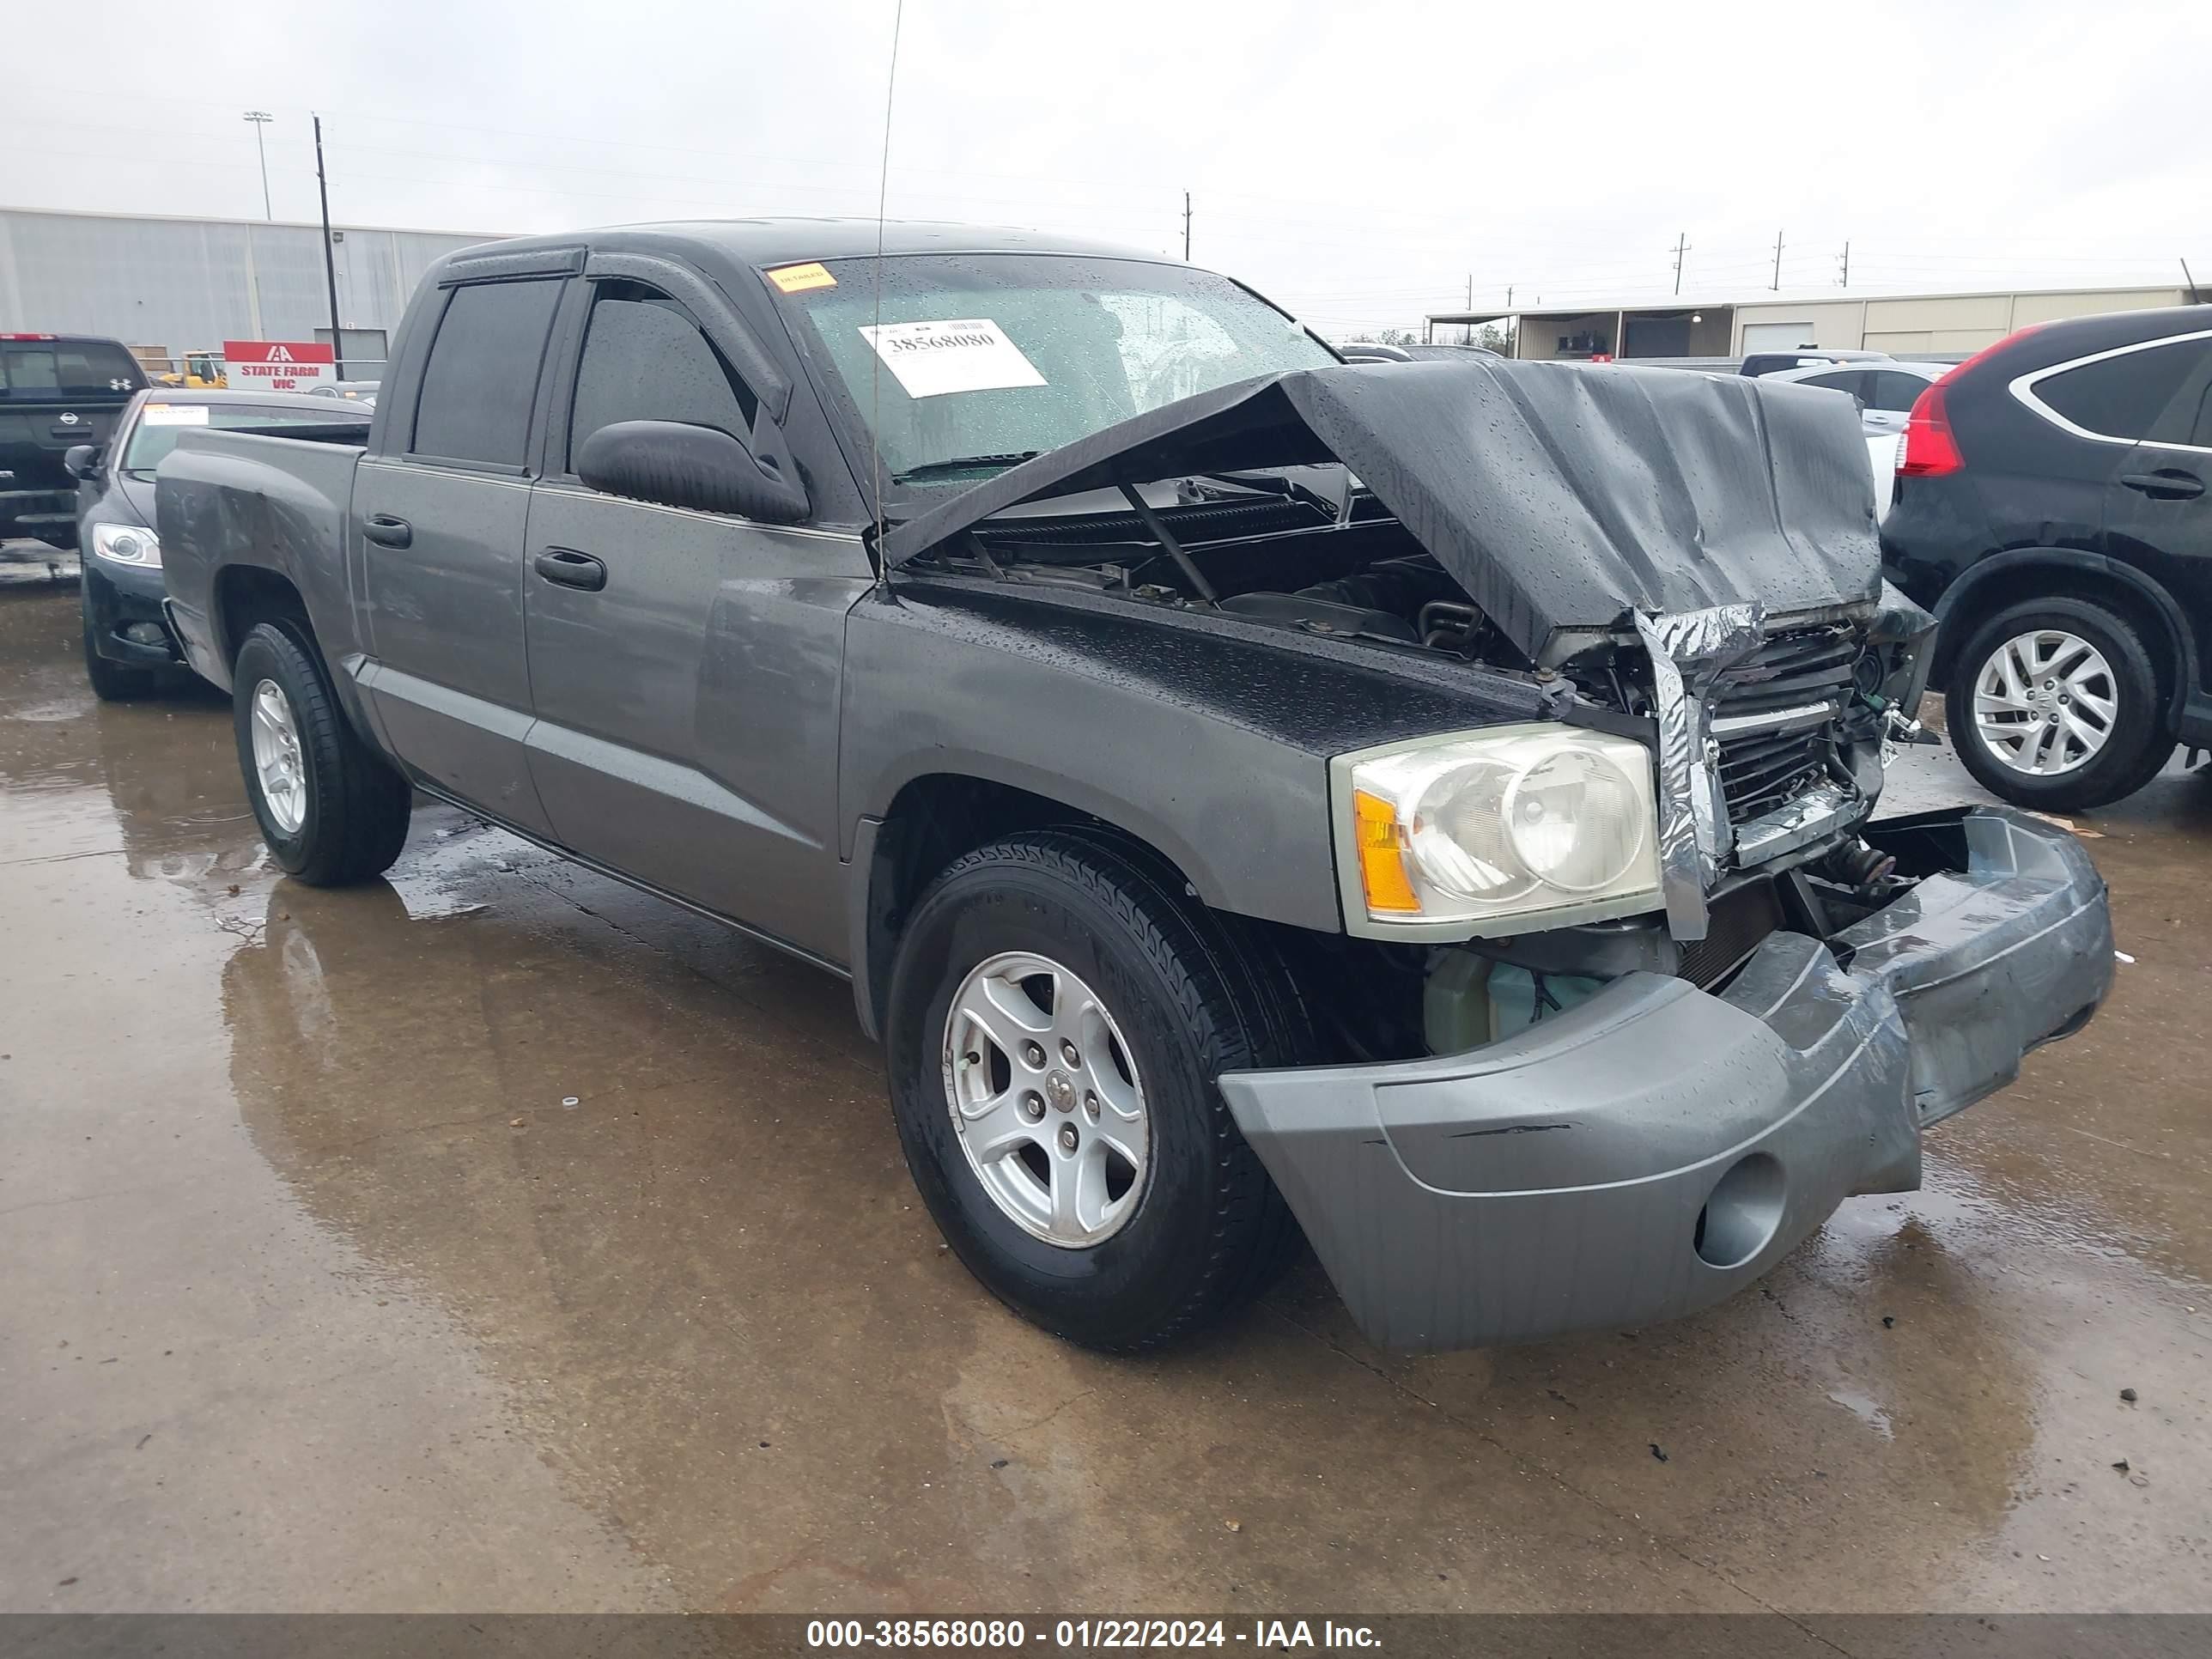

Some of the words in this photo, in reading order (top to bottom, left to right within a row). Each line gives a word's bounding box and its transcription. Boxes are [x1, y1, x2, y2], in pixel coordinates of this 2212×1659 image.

[887, 333, 995, 354] 38568080
[240, 365, 282, 377] STATE
[283, 366, 320, 377] FARM
[271, 379, 296, 389] VIC
